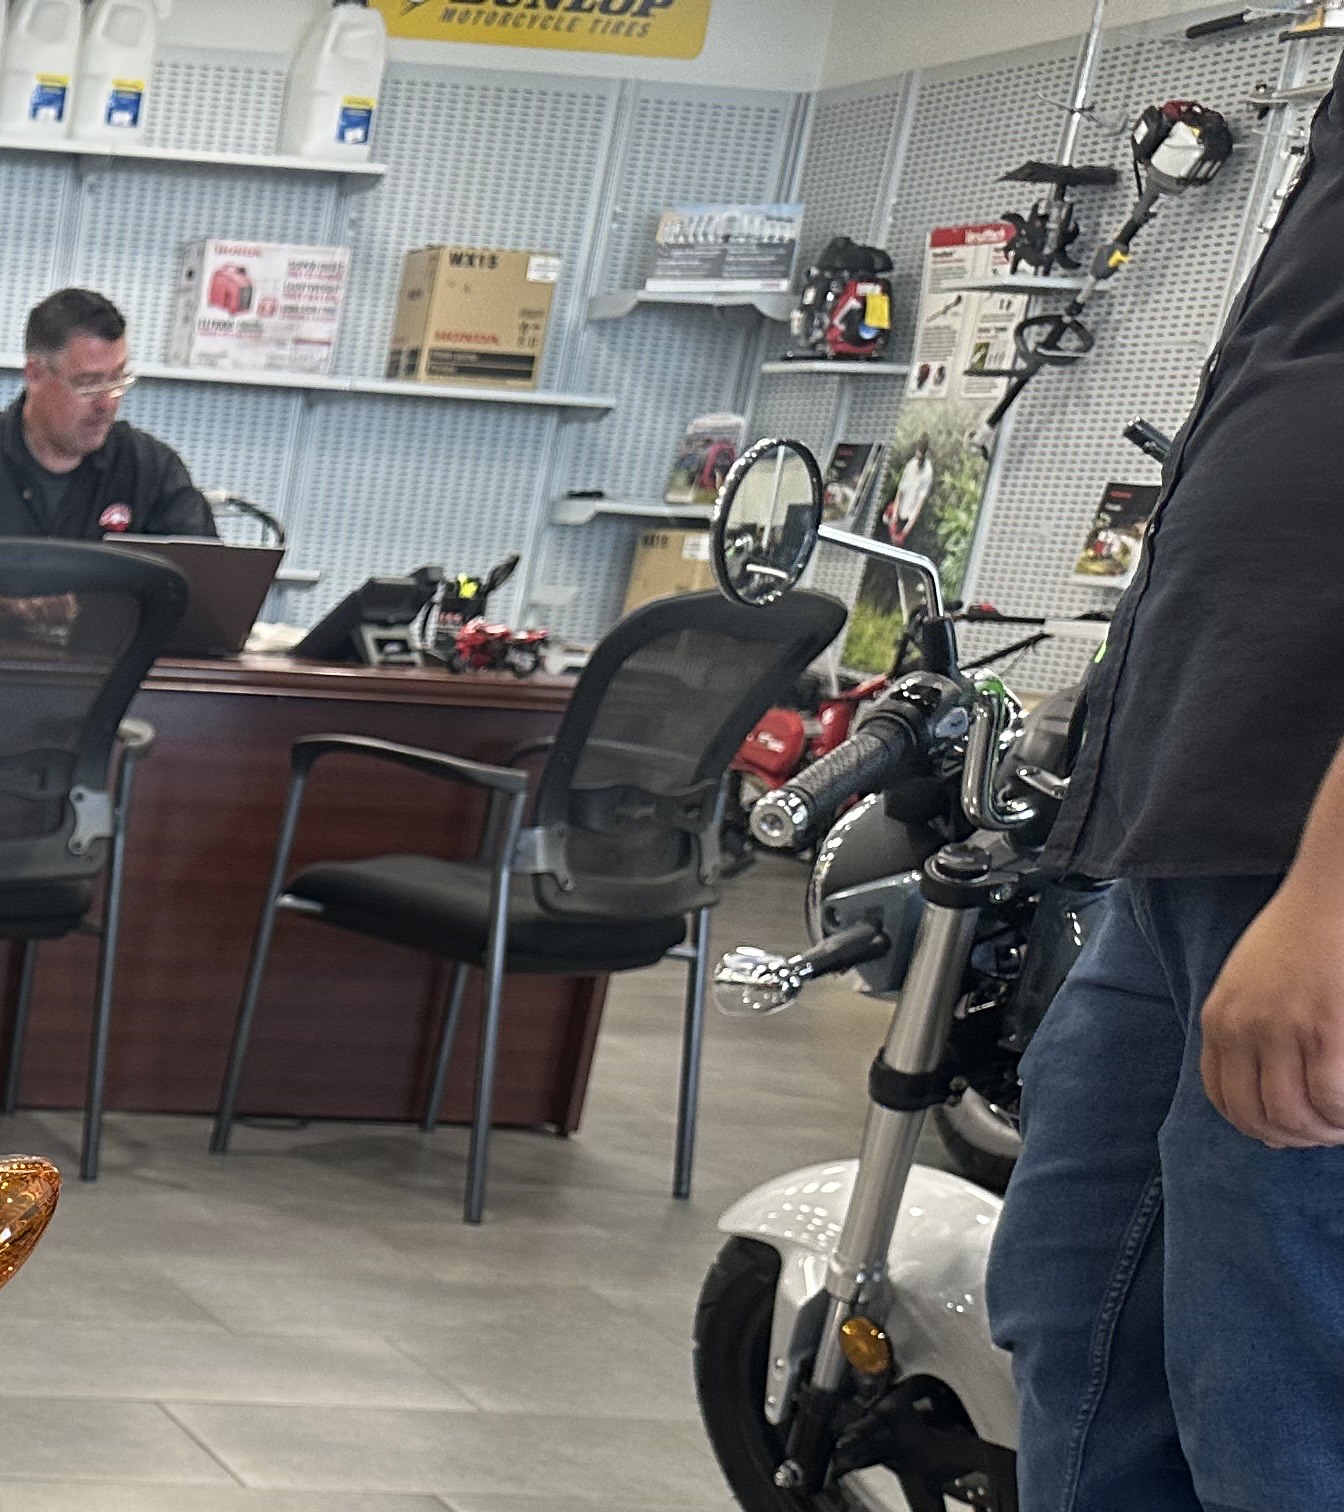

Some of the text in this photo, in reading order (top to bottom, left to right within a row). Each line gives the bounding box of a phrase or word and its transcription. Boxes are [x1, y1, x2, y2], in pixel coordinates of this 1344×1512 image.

[449, 0, 673, 17] NLOP
[440, 7, 651, 38] MOTORCYCLE TIRES
